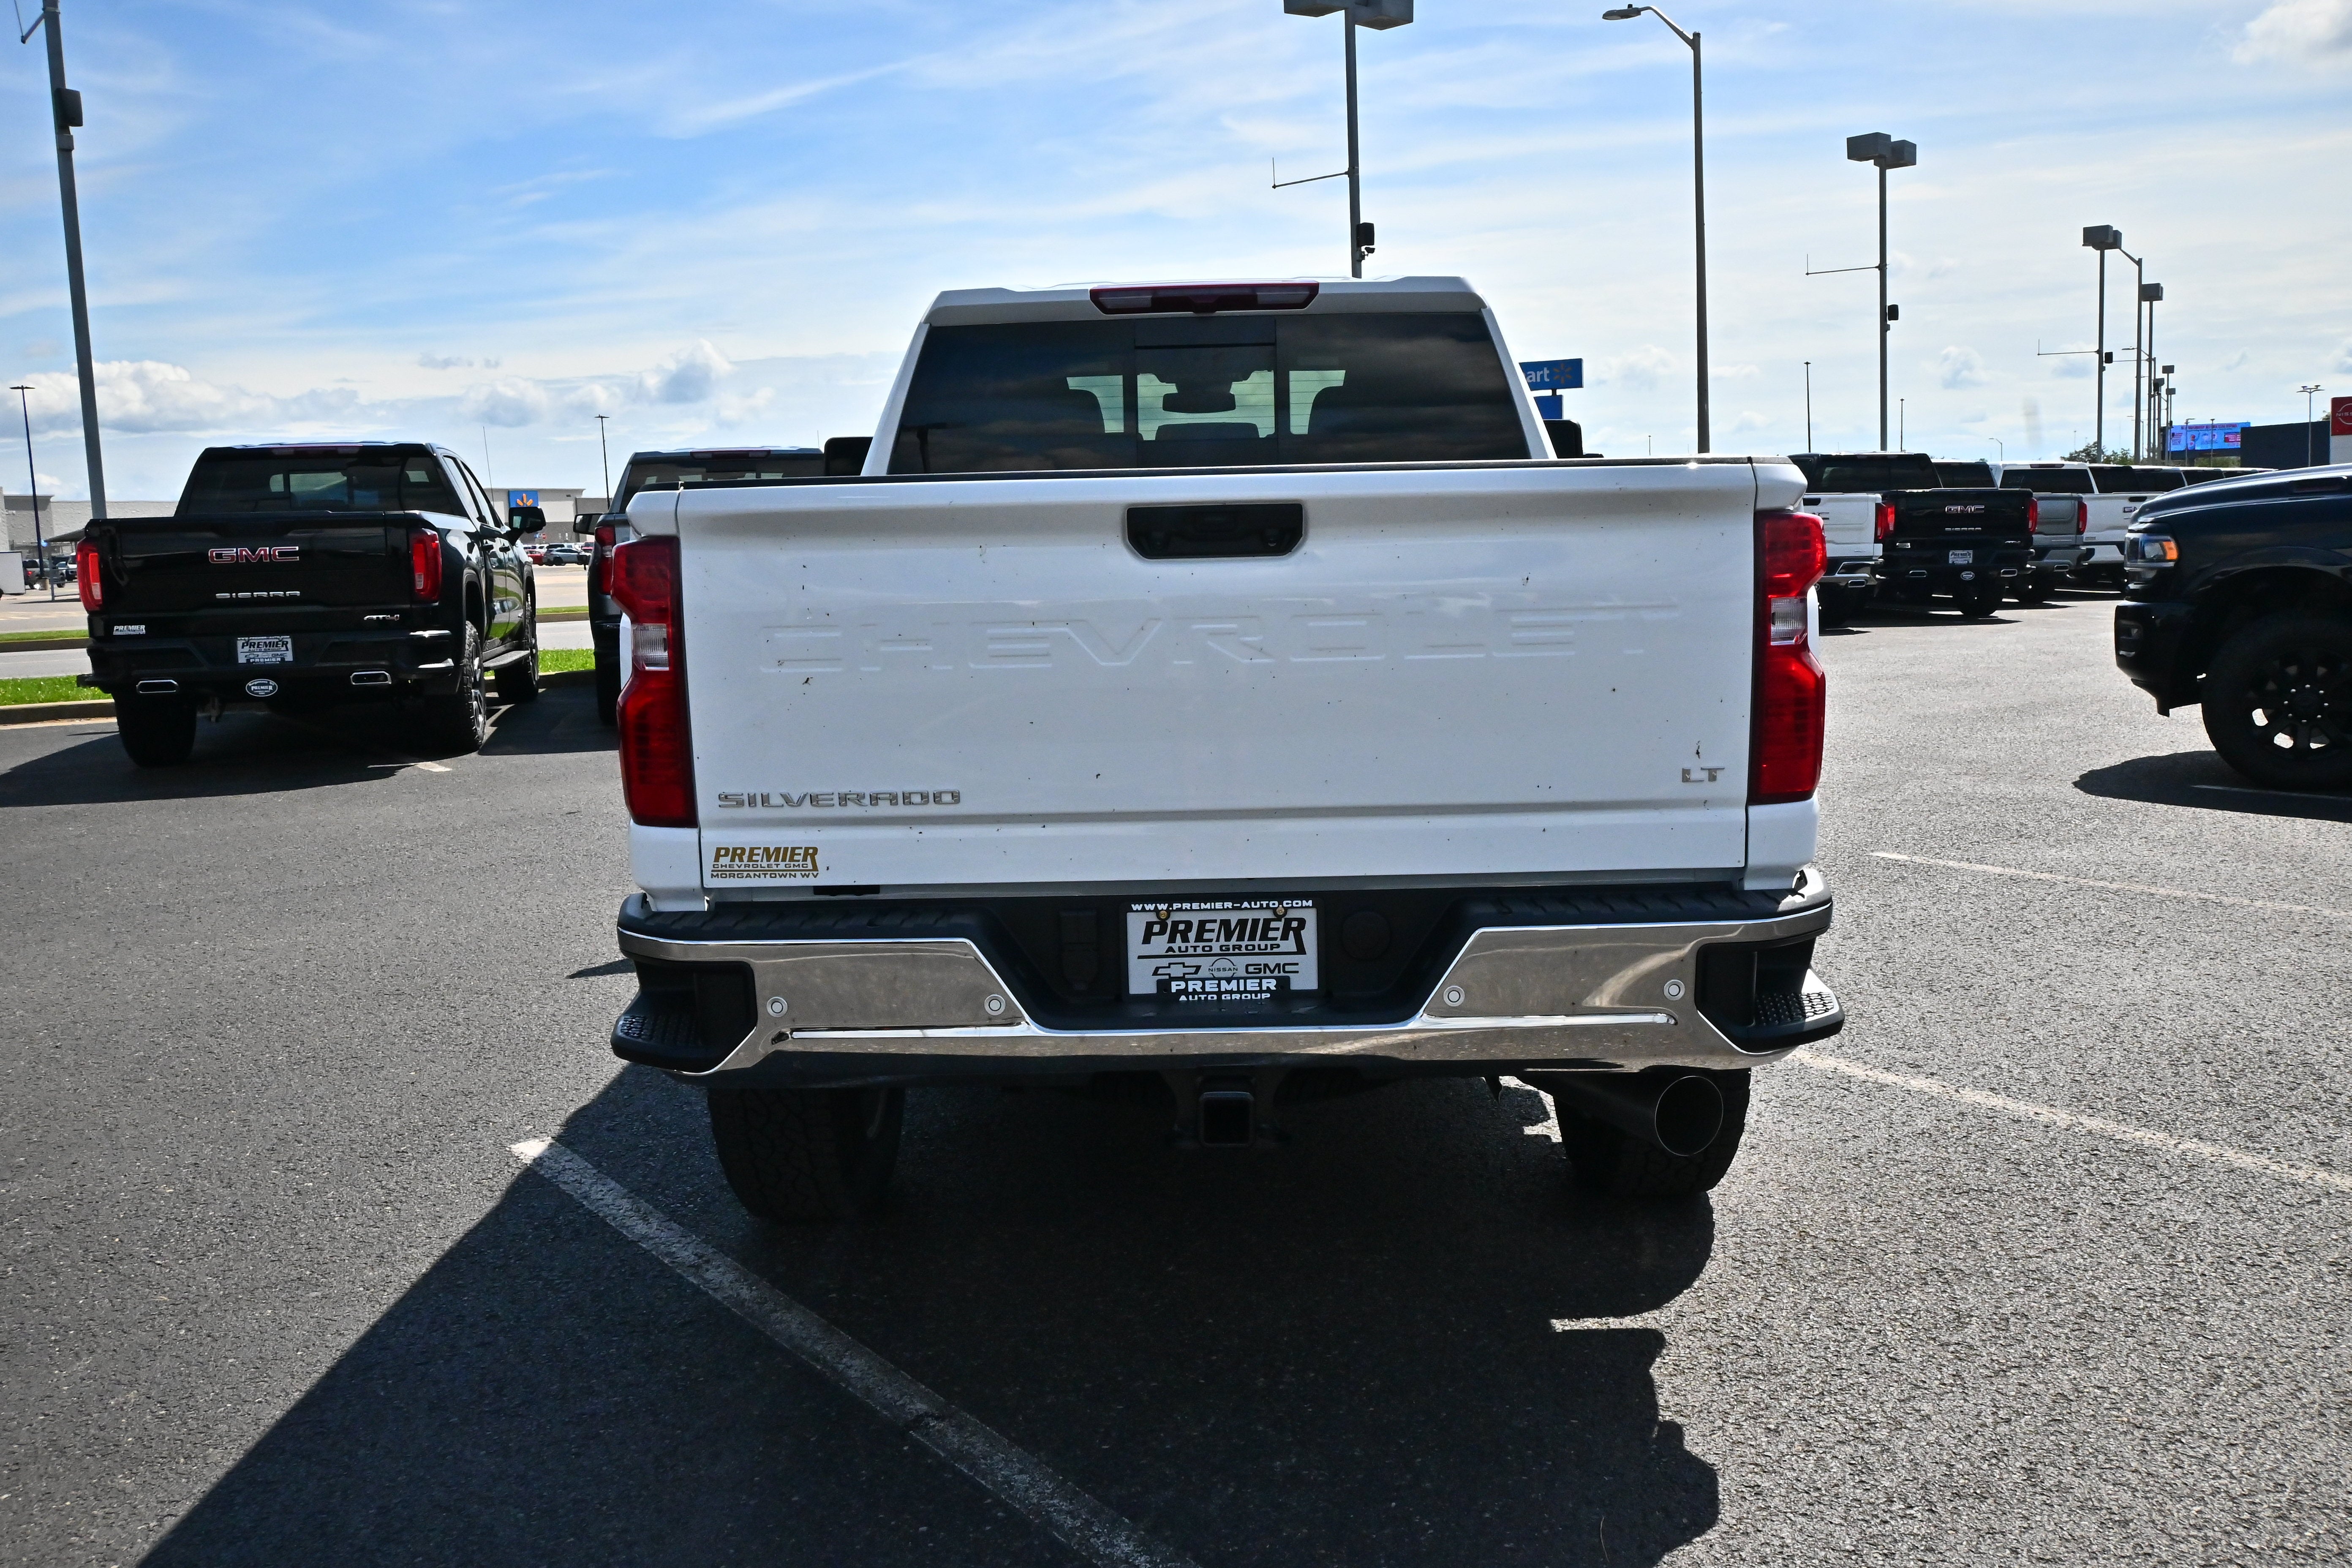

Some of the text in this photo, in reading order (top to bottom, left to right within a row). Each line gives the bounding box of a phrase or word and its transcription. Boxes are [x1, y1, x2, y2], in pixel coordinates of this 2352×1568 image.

[1945, 505, 1985, 514] GMC
[208, 546, 299, 564] GMC
[760, 602, 1680, 673] CHEVROLET
[241, 640, 289, 651] PREMIER
[1681, 766, 1725, 782] LT
[718, 790, 961, 808] SILVERADO
[713, 847, 819, 870] PREMIER
[1131, 900, 1312, 911] WWW.PREMIER-AUTO.COM
[1141, 917, 1307, 953] PREMIER
[1165, 944, 1281, 953] AUTO GROUP
[1245, 963, 1299, 975] GMC
[1171, 978, 1277, 993] PREMIER
